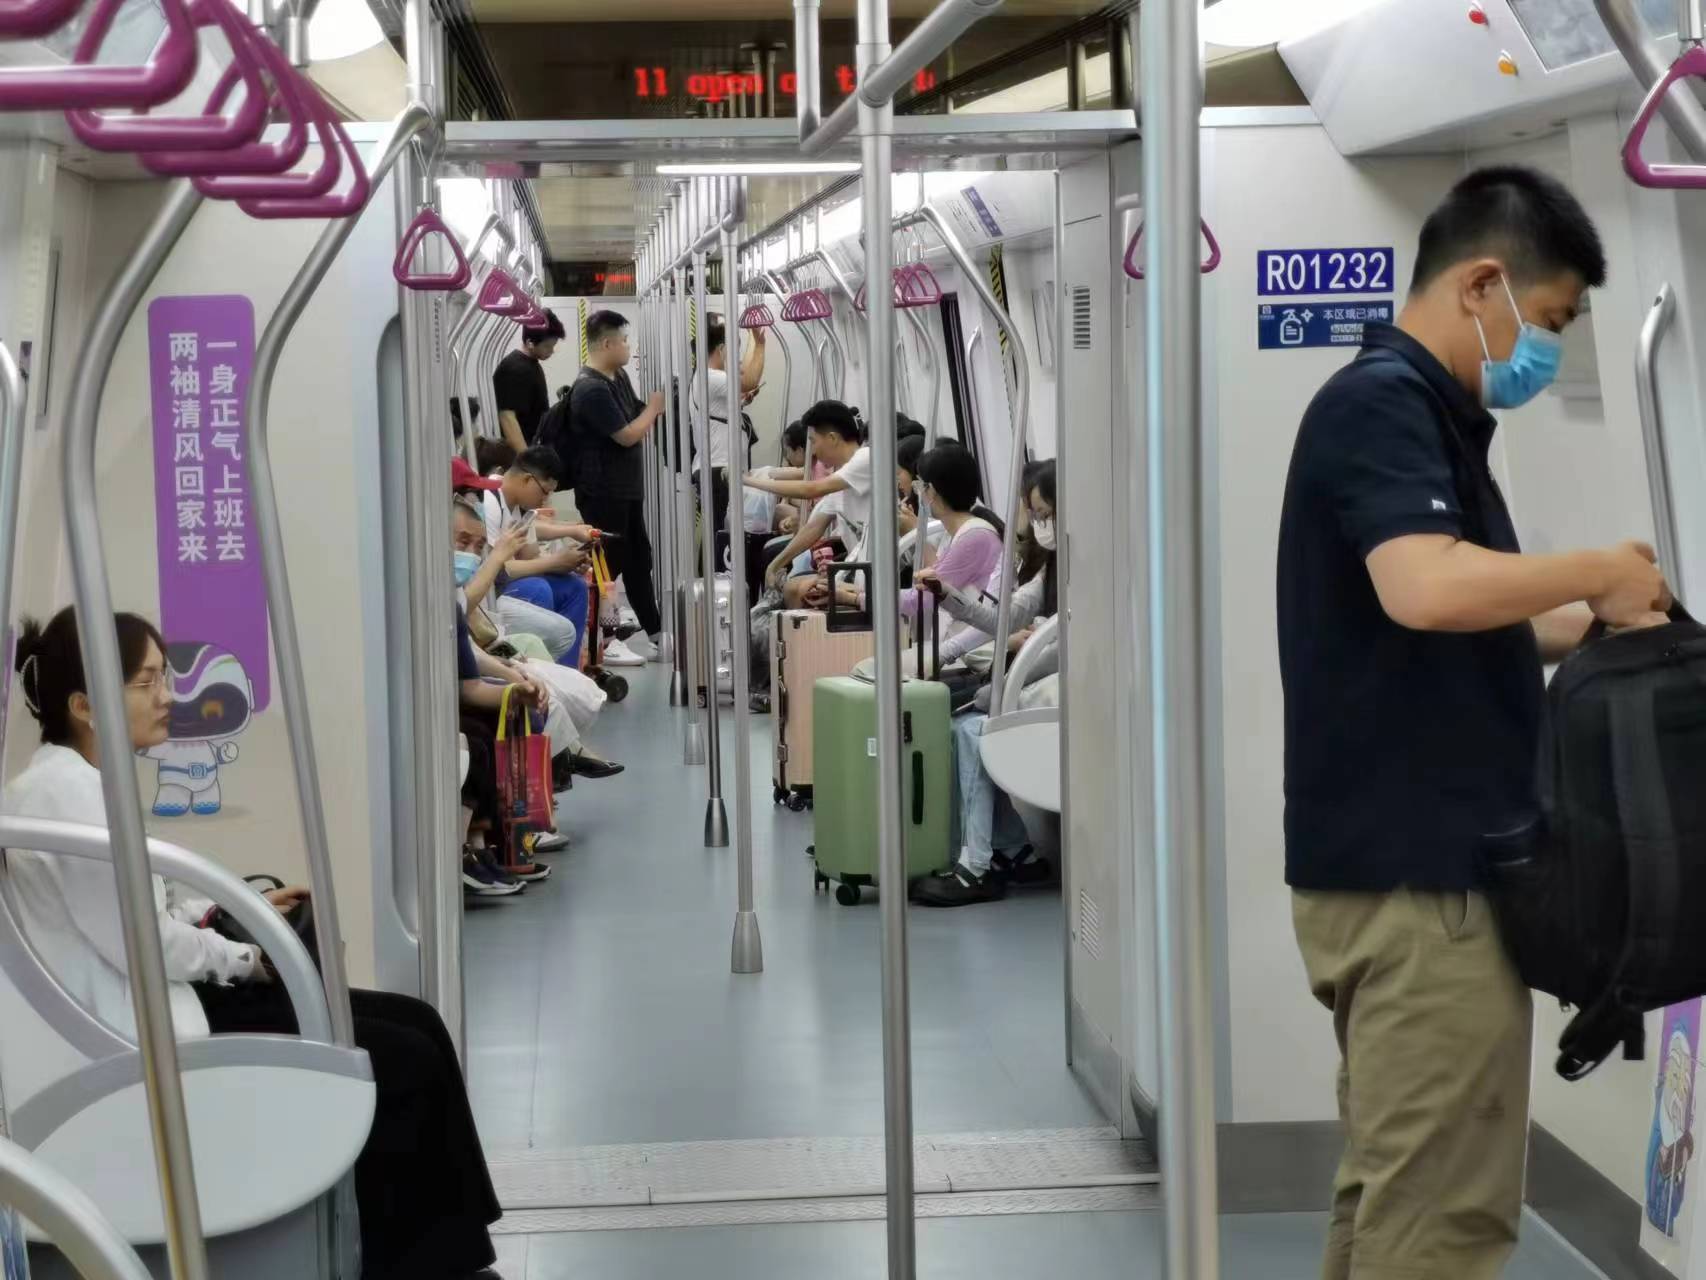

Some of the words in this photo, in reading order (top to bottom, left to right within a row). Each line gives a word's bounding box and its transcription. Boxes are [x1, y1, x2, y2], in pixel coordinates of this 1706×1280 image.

[686, 73, 763, 103] open
[1266, 251, 1388, 291] R01232
[168, 332, 208, 563] 两袖清风回家来
[206, 340, 245, 561] 一身正气上班去
